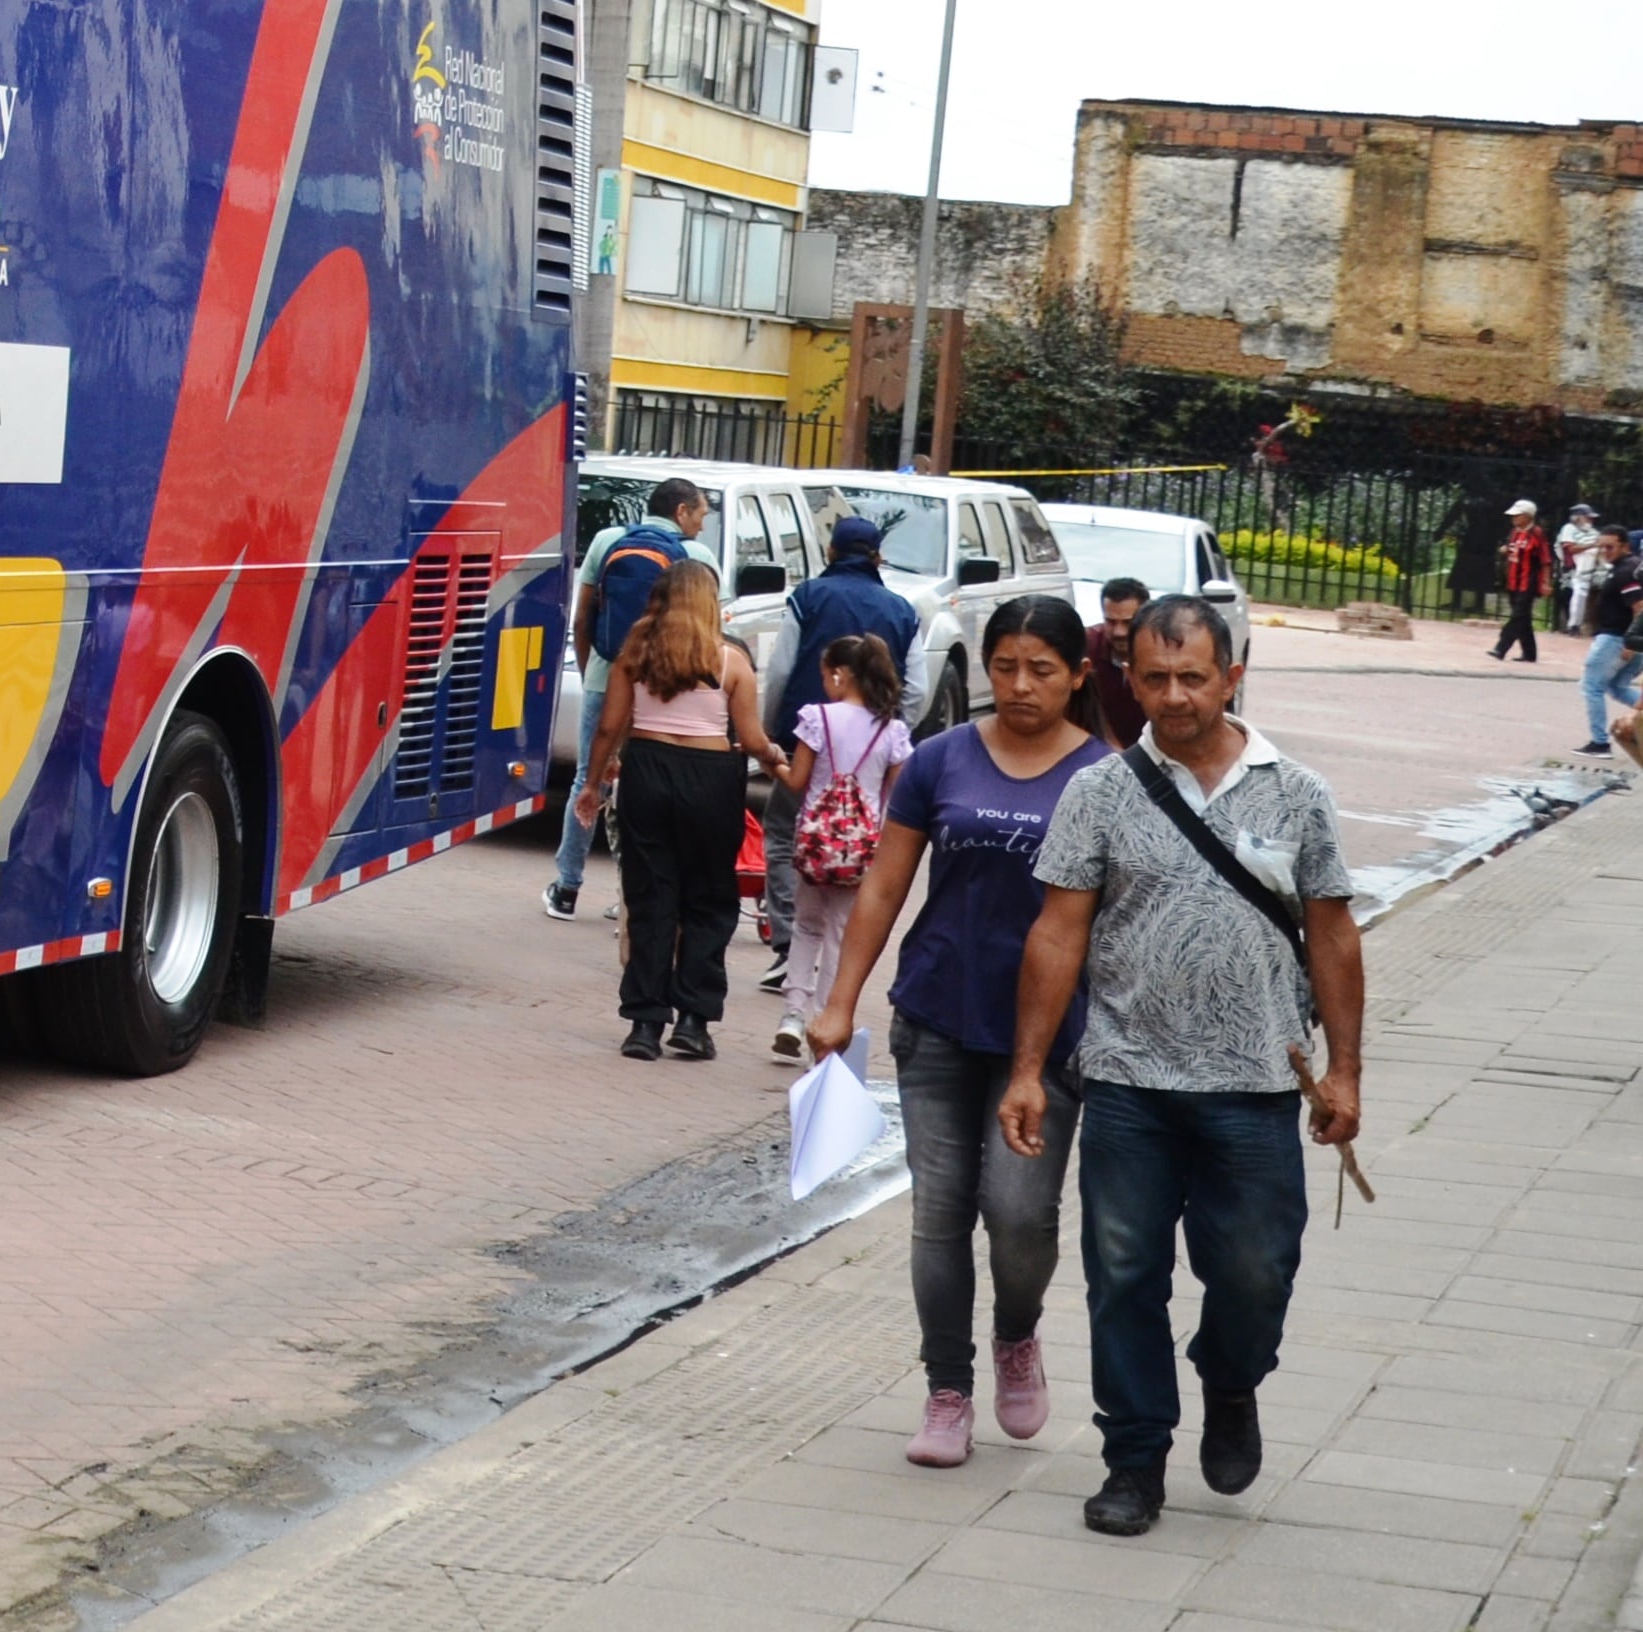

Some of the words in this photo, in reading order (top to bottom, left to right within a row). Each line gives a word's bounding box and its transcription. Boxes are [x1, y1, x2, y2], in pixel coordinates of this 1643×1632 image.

[444, 45, 464, 85] Red
[466, 50, 505, 95] Nacional
[445, 86, 457, 122] de
[459, 87, 505, 133] Protección
[443, 125, 453, 160] al
[454, 125, 505, 172] Consumidor
[976, 807, 1009, 820] you
[1013, 811, 1042, 824] are
